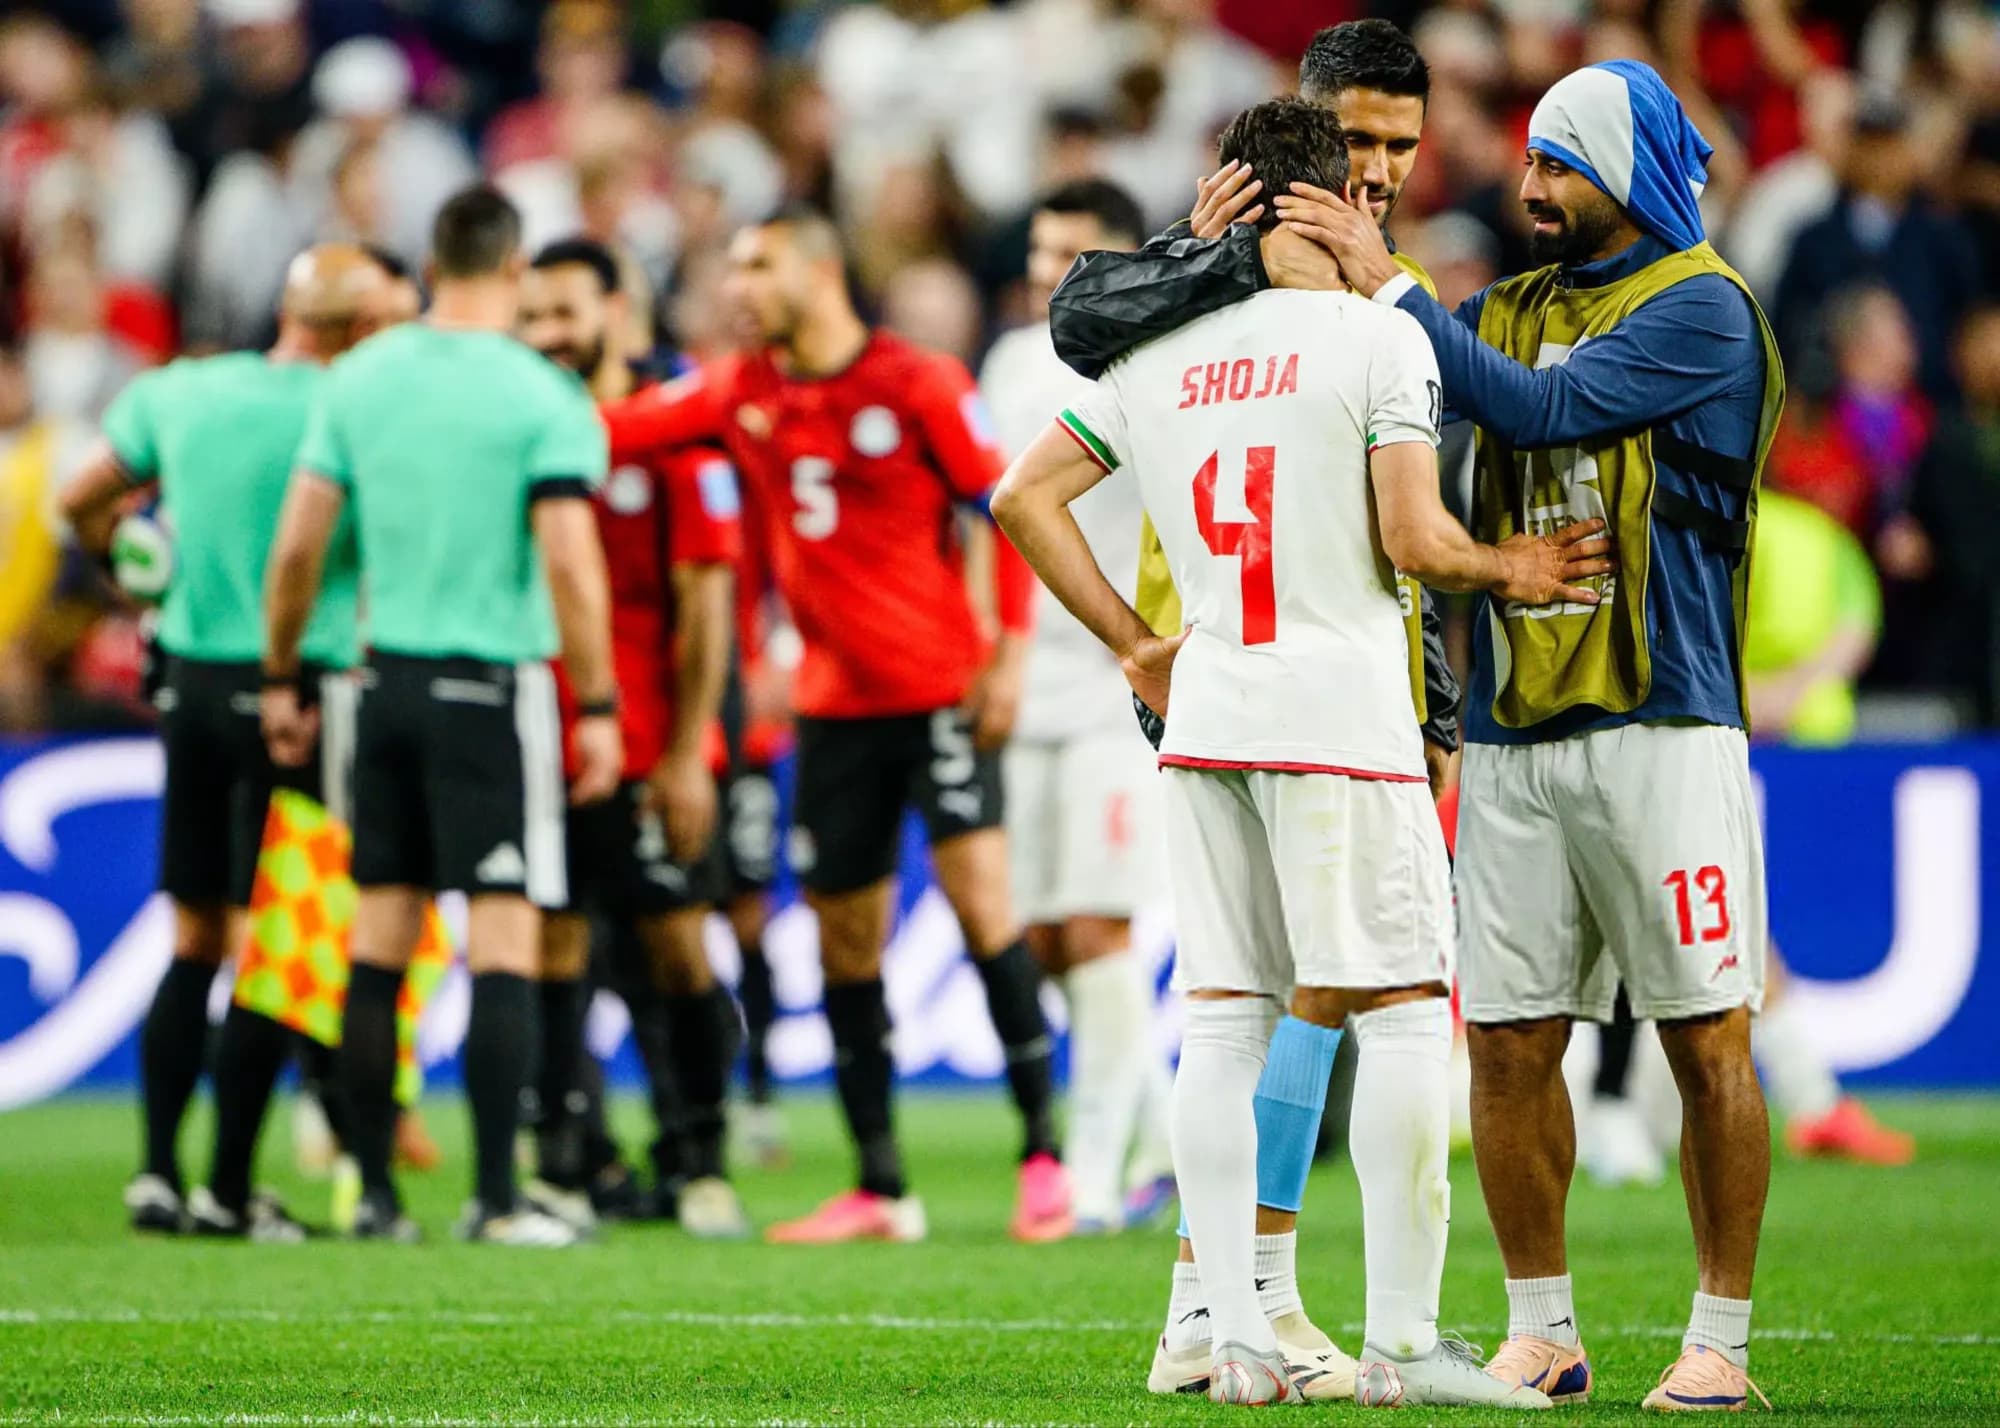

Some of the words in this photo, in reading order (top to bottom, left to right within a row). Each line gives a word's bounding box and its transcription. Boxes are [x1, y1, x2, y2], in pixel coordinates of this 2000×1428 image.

[1178, 353, 1299, 410] SHOJA
[791, 456, 839, 540] 5
[1191, 445, 1276, 646] 4
[929, 706, 976, 786] 5
[1662, 864, 1730, 946] 13
